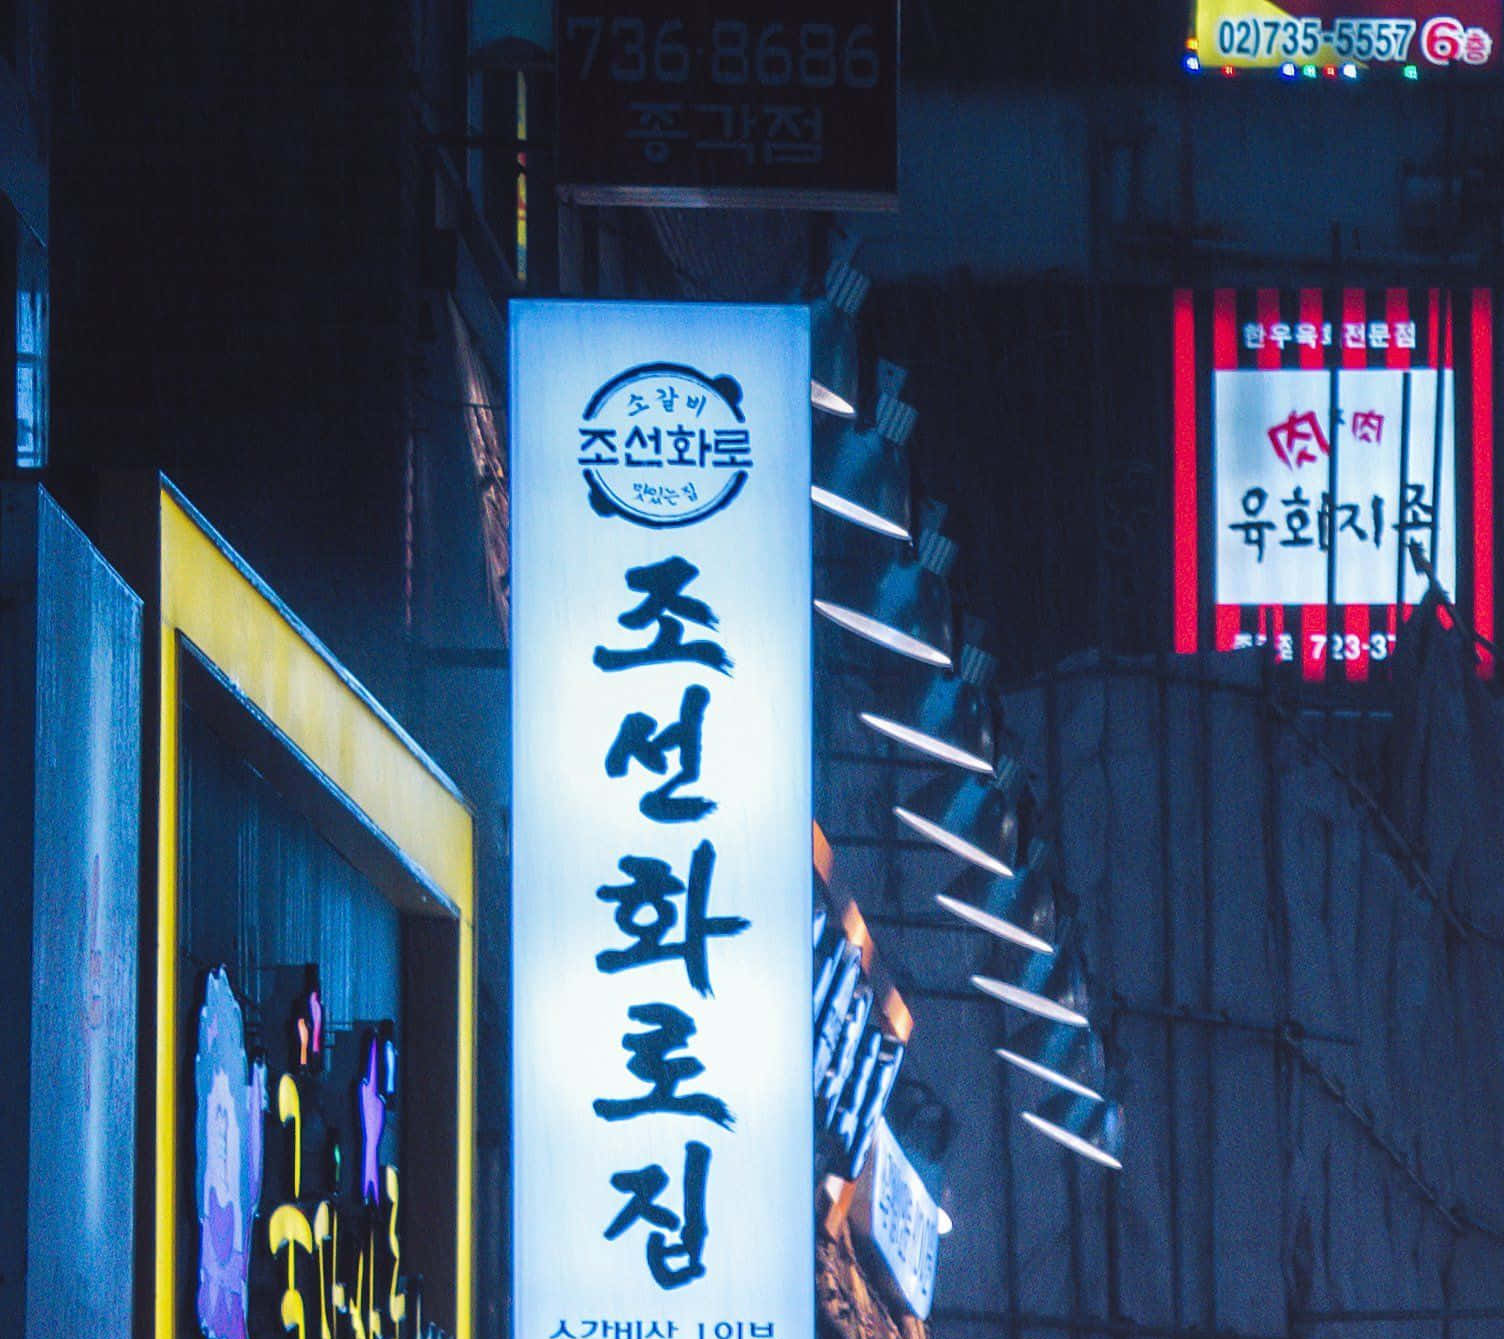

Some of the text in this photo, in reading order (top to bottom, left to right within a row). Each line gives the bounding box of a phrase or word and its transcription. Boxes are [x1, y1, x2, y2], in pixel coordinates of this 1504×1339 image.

[1218, 15, 1495, 66] 02)735-5557 6층
[625, 101, 826, 167] 종각점
[1341, 320, 1418, 351] 전문점
[628, 386, 708, 418] 소갈비
[577, 423, 754, 471] 조선화로
[592, 555, 752, 1291] 조선화로집
